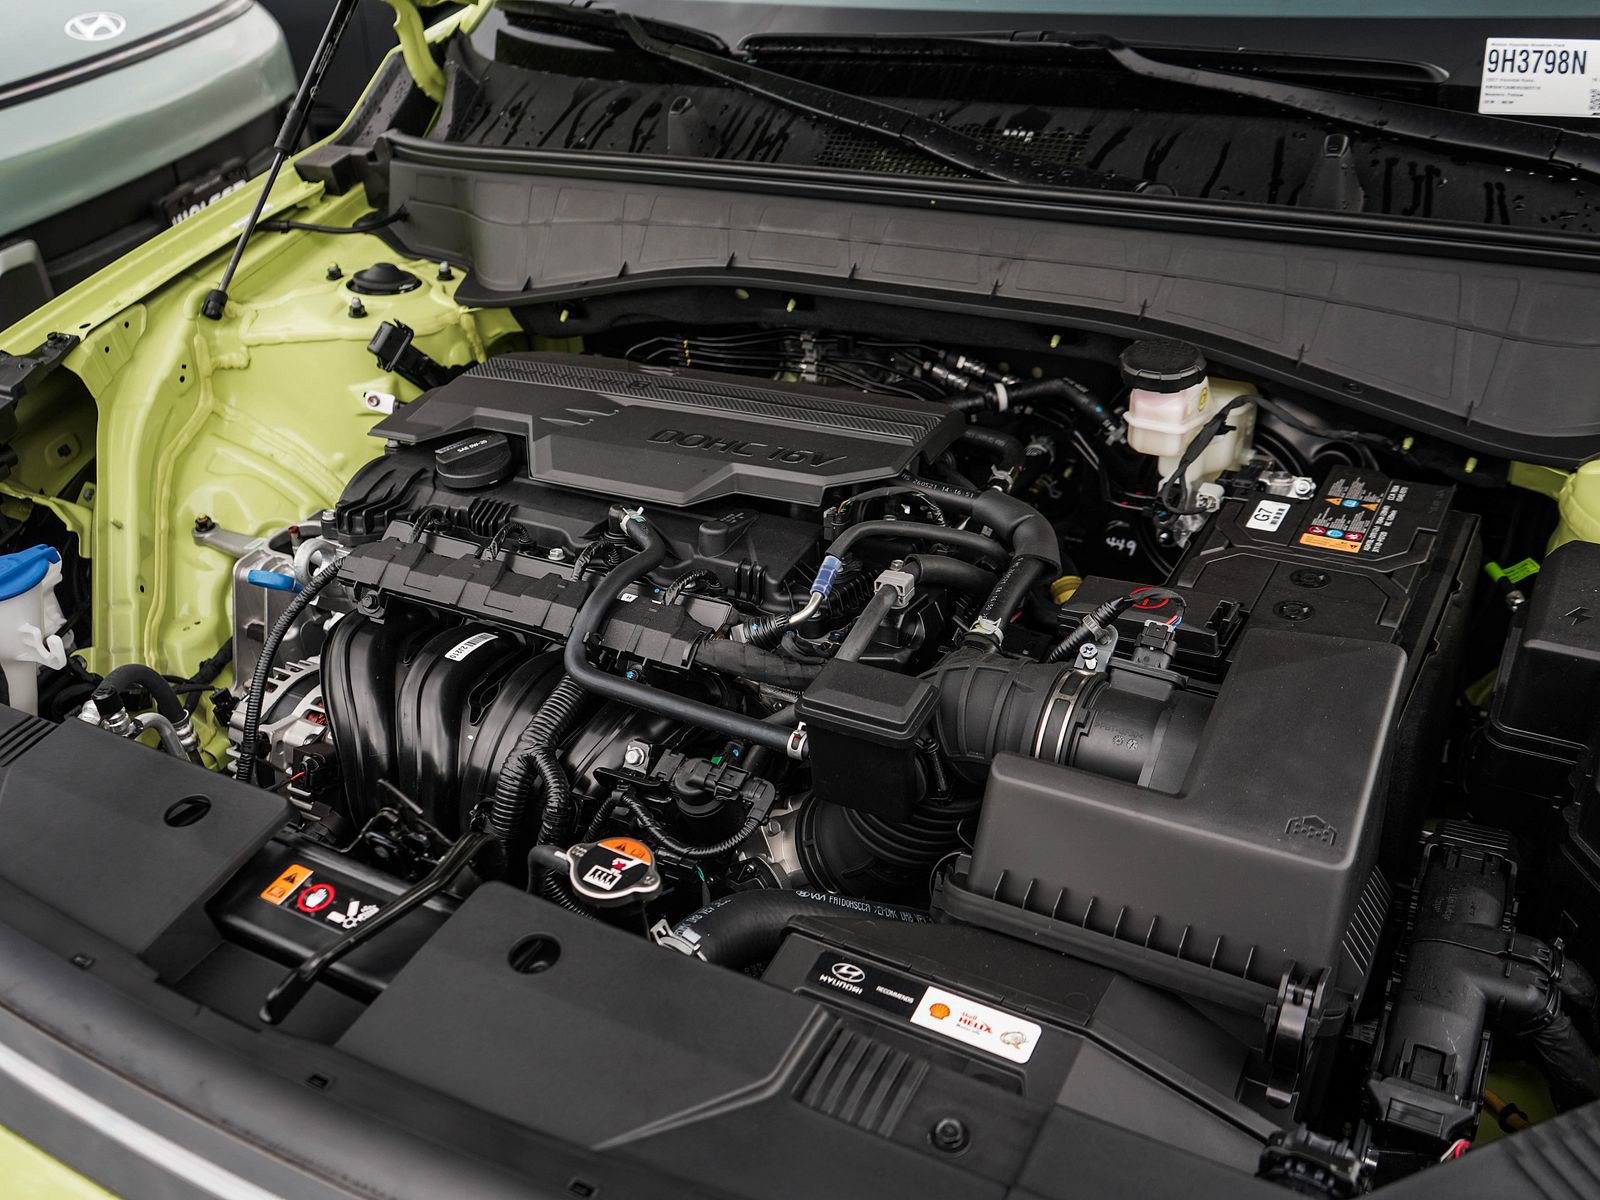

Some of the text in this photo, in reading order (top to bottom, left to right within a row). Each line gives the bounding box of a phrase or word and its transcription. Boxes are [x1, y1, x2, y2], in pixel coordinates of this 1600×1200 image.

[1488, 49, 1587, 75] 9H3798N
[646, 429, 847, 468] DOHC 16V
[1254, 507, 1273, 522] G7
[819, 973, 864, 996] HYUNDAI
[958, 1017, 992, 1034] HELIX
